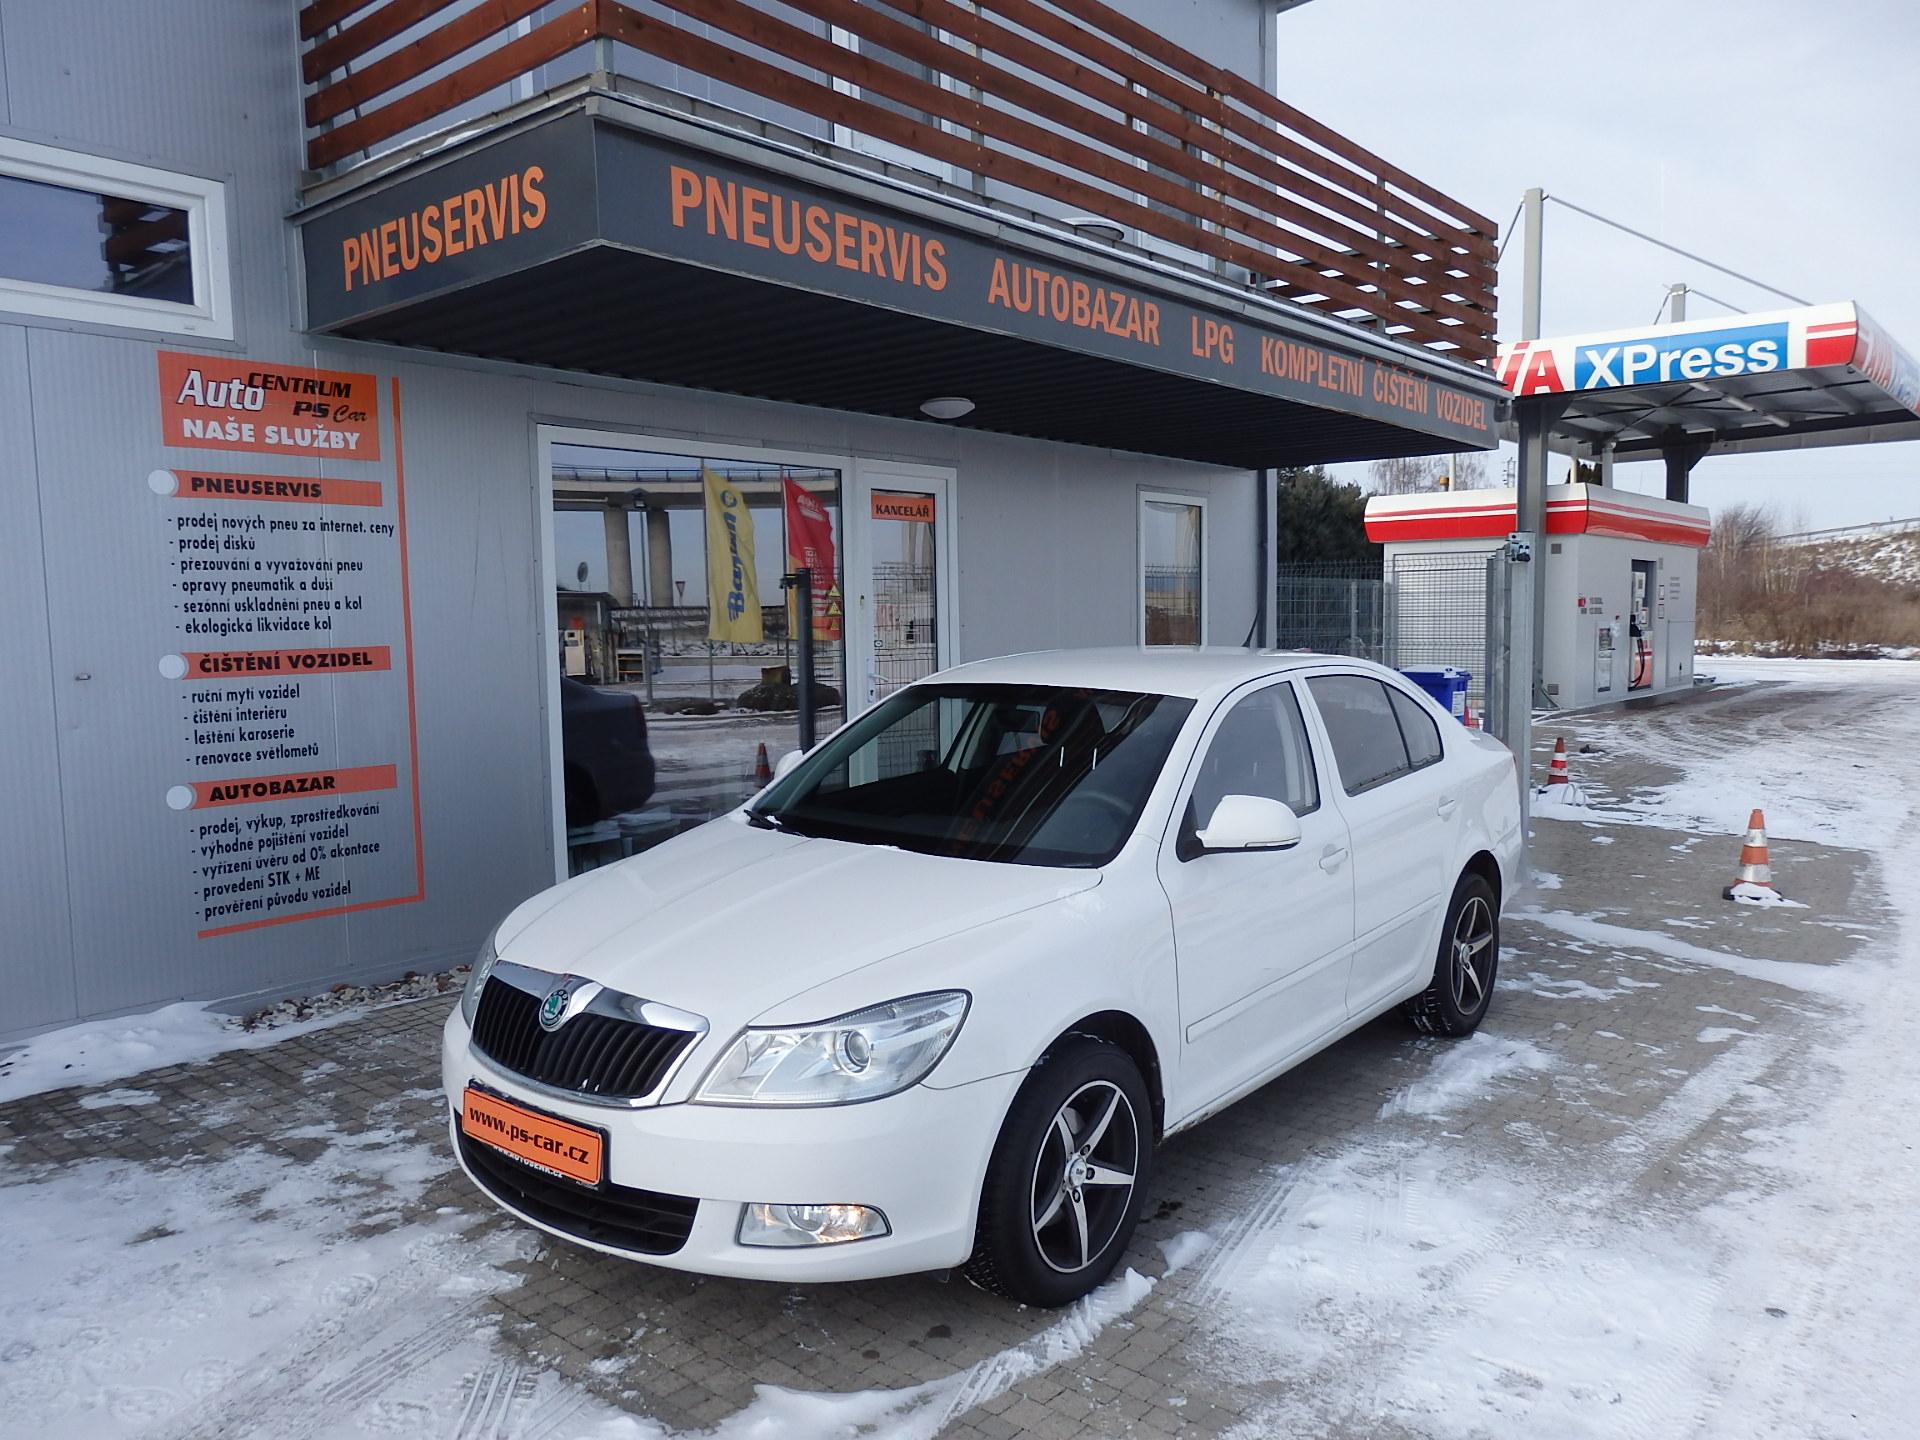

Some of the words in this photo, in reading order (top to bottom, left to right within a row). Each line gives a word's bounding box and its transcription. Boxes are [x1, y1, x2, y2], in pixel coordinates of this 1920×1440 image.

[343, 165, 548, 293] PNEUSERVIS
[670, 164, 949, 293] PNEUSERVIS
[988, 257, 1160, 347] AUTOBAZAR
[1191, 315, 1235, 365] LPG
[1261, 335, 1364, 398] KOMPLETNÍ
[1372, 360, 1429, 414] ČIŠTĚNÍ
[1436, 388, 1488, 431] VOZIDEL
[177, 369, 265, 412] Auto
[247, 372, 352, 399] CENTRUM
[293, 400, 331, 418] PS
[332, 404, 368, 423] Car
[183, 416, 256, 443] NAŠE
[264, 423, 361, 450] SLUŽBY
[191, 476, 322, 498] PNEUSERVIS
[875, 503, 930, 518] KANCELÁŘ
[177, 513, 218, 532] prodej
[222, 514, 265, 534] nových
[270, 519, 298, 533] pneu
[302, 520, 316, 531] za
[320, 518, 367, 533] internet.
[370, 523, 395, 538] ceny
[179, 535, 219, 553] prodej
[180, 557, 250, 574] přezouvání
[254, 561, 262, 571] a
[266, 557, 333, 574] vyvažování
[337, 561, 363, 574] pneu
[182, 580, 227, 595] opravy
[231, 576, 295, 595] pneumatik
[300, 581, 307, 591] a
[183, 598, 229, 613] sezónní
[234, 596, 299, 612] uskladnění
[304, 600, 330, 614] pneu
[334, 601, 341, 610] a
[345, 596, 362, 610] kol
[185, 617, 253, 636] ekologická
[257, 616, 310, 632] likvidace
[314, 616, 332, 630] kol
[200, 652, 281, 673] ČIŠTĚNÍ
[287, 652, 373, 670] VOZIDEL
[192, 687, 222, 704] ruční
[258, 683, 300, 700] vozidel
[193, 707, 232, 725] čištění
[236, 705, 287, 723] interiéru
[194, 726, 235, 745] leštění
[239, 724, 295, 742] karoserie
[195, 751, 252, 766] renovace
[256, 742, 319, 760] světlometů
[209, 776, 336, 802] AUTOBAZAR
[200, 816, 242, 839] prodej,
[246, 813, 286, 834] výkup,
[290, 801, 380, 825] zprostředkování
[258, 831, 306, 851] pojištění
[309, 823, 349, 842] vozidel
[202, 857, 252, 880] vyřízení
[292, 848, 306, 863] od
[310, 846, 327, 861] 0%
[330, 841, 380, 859] akontace
[203, 878, 264, 901] provedení
[267, 872, 290, 888] STK
[305, 866, 320, 882] ME
[204, 899, 263, 921] prověření
[266, 892, 309, 911] původu
[312, 880, 351, 899] vozidel
[469, 1107, 590, 1165] www.ps-car.cz
